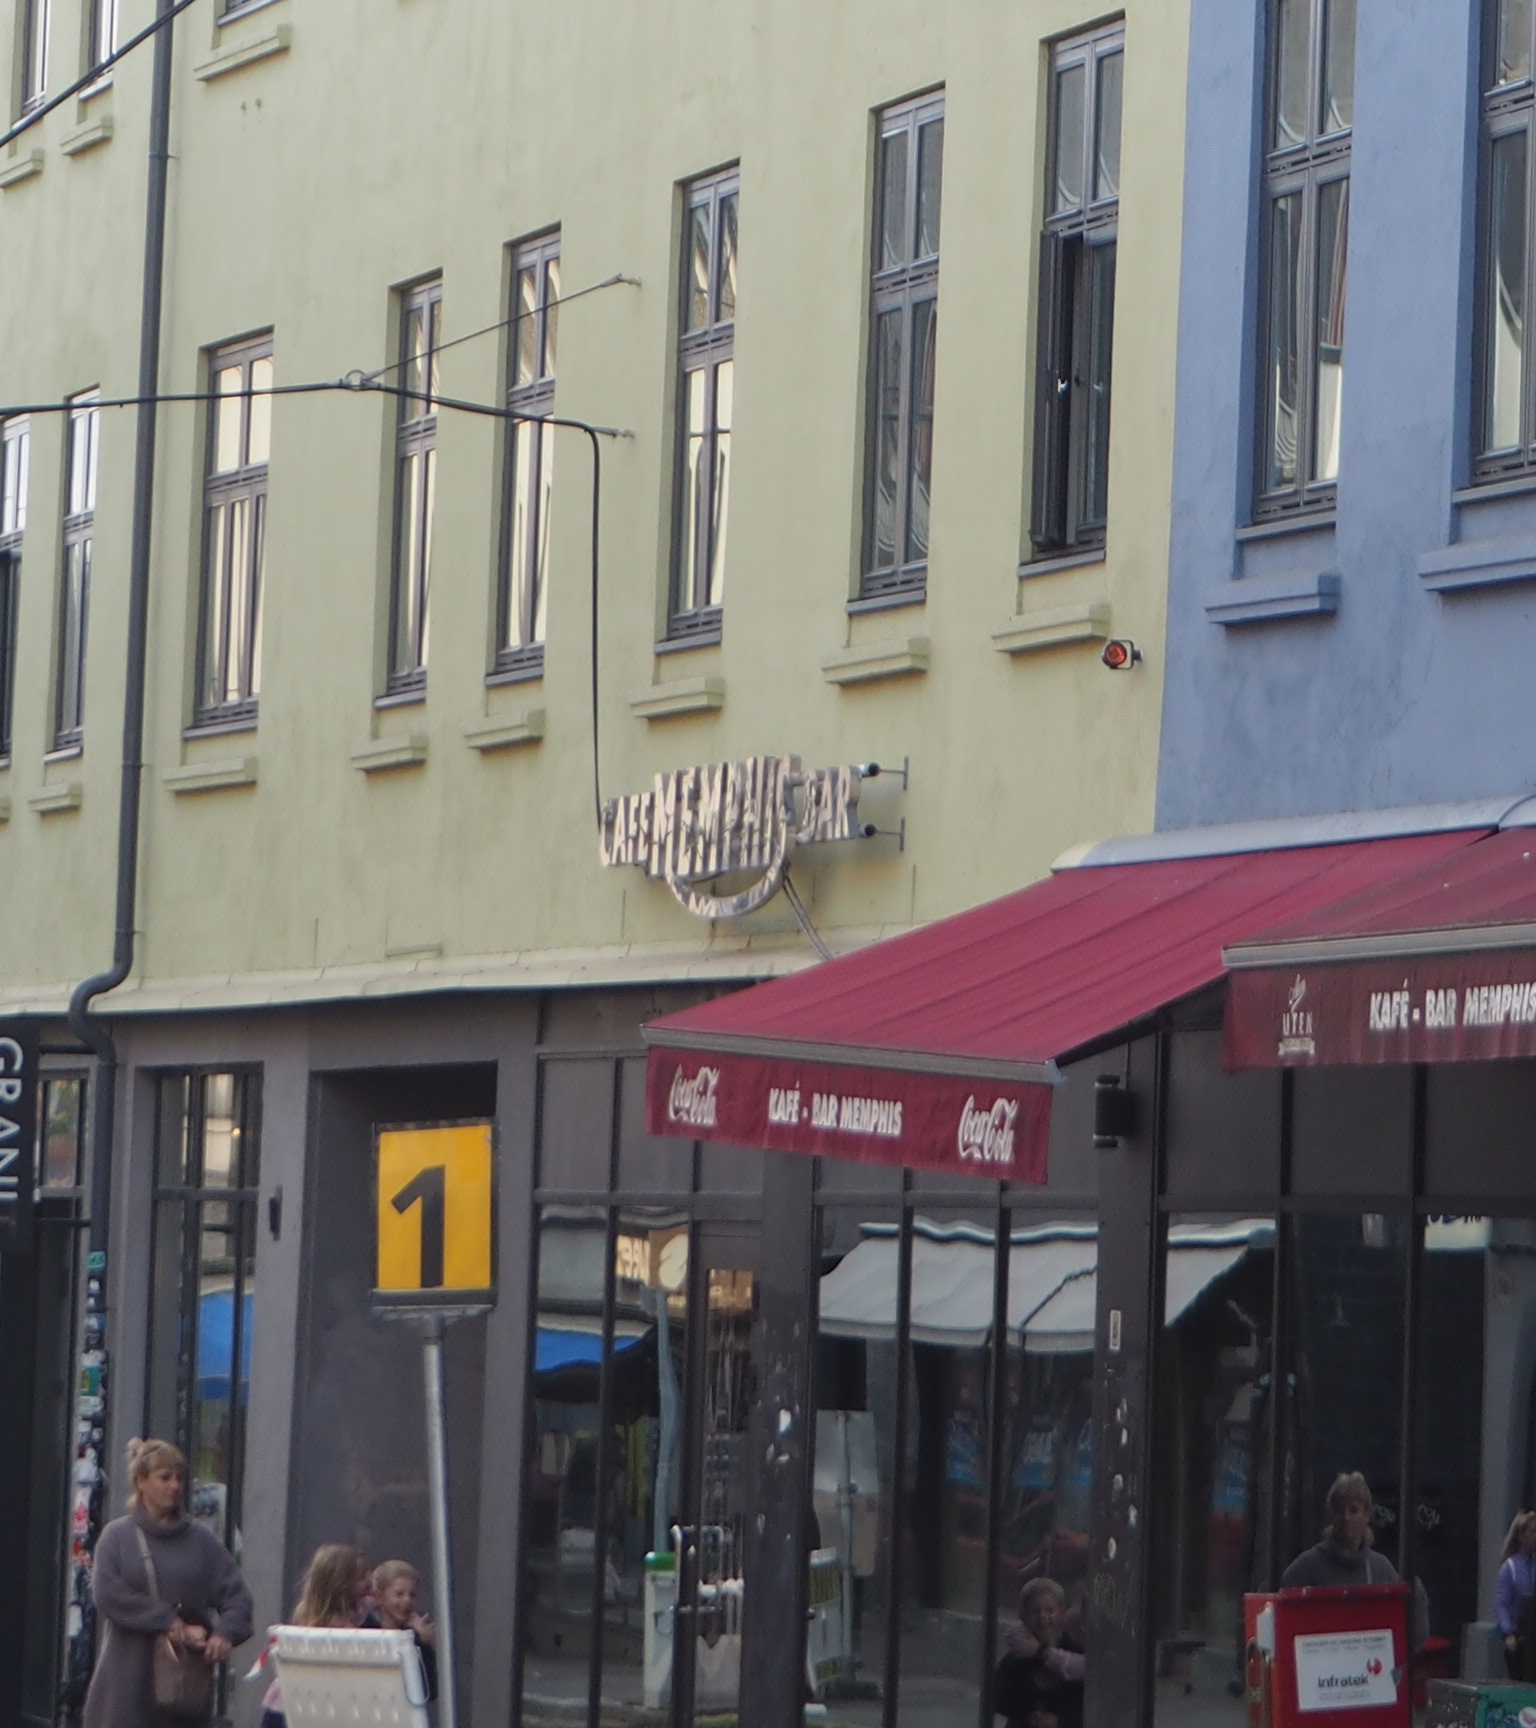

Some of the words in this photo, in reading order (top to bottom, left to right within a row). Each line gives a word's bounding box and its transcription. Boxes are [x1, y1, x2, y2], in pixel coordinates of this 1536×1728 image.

[650, 754, 800, 878] MEMPHIS
[796, 765, 862, 845] BAR
[1425, 989, 1457, 1028] BAR
[811, 1092, 839, 1127] BAR
[839, 1094, 904, 1137] MEMPHIS
[390, 1163, 446, 1289] 1
[1317, 1674, 1369, 1689] infratek
